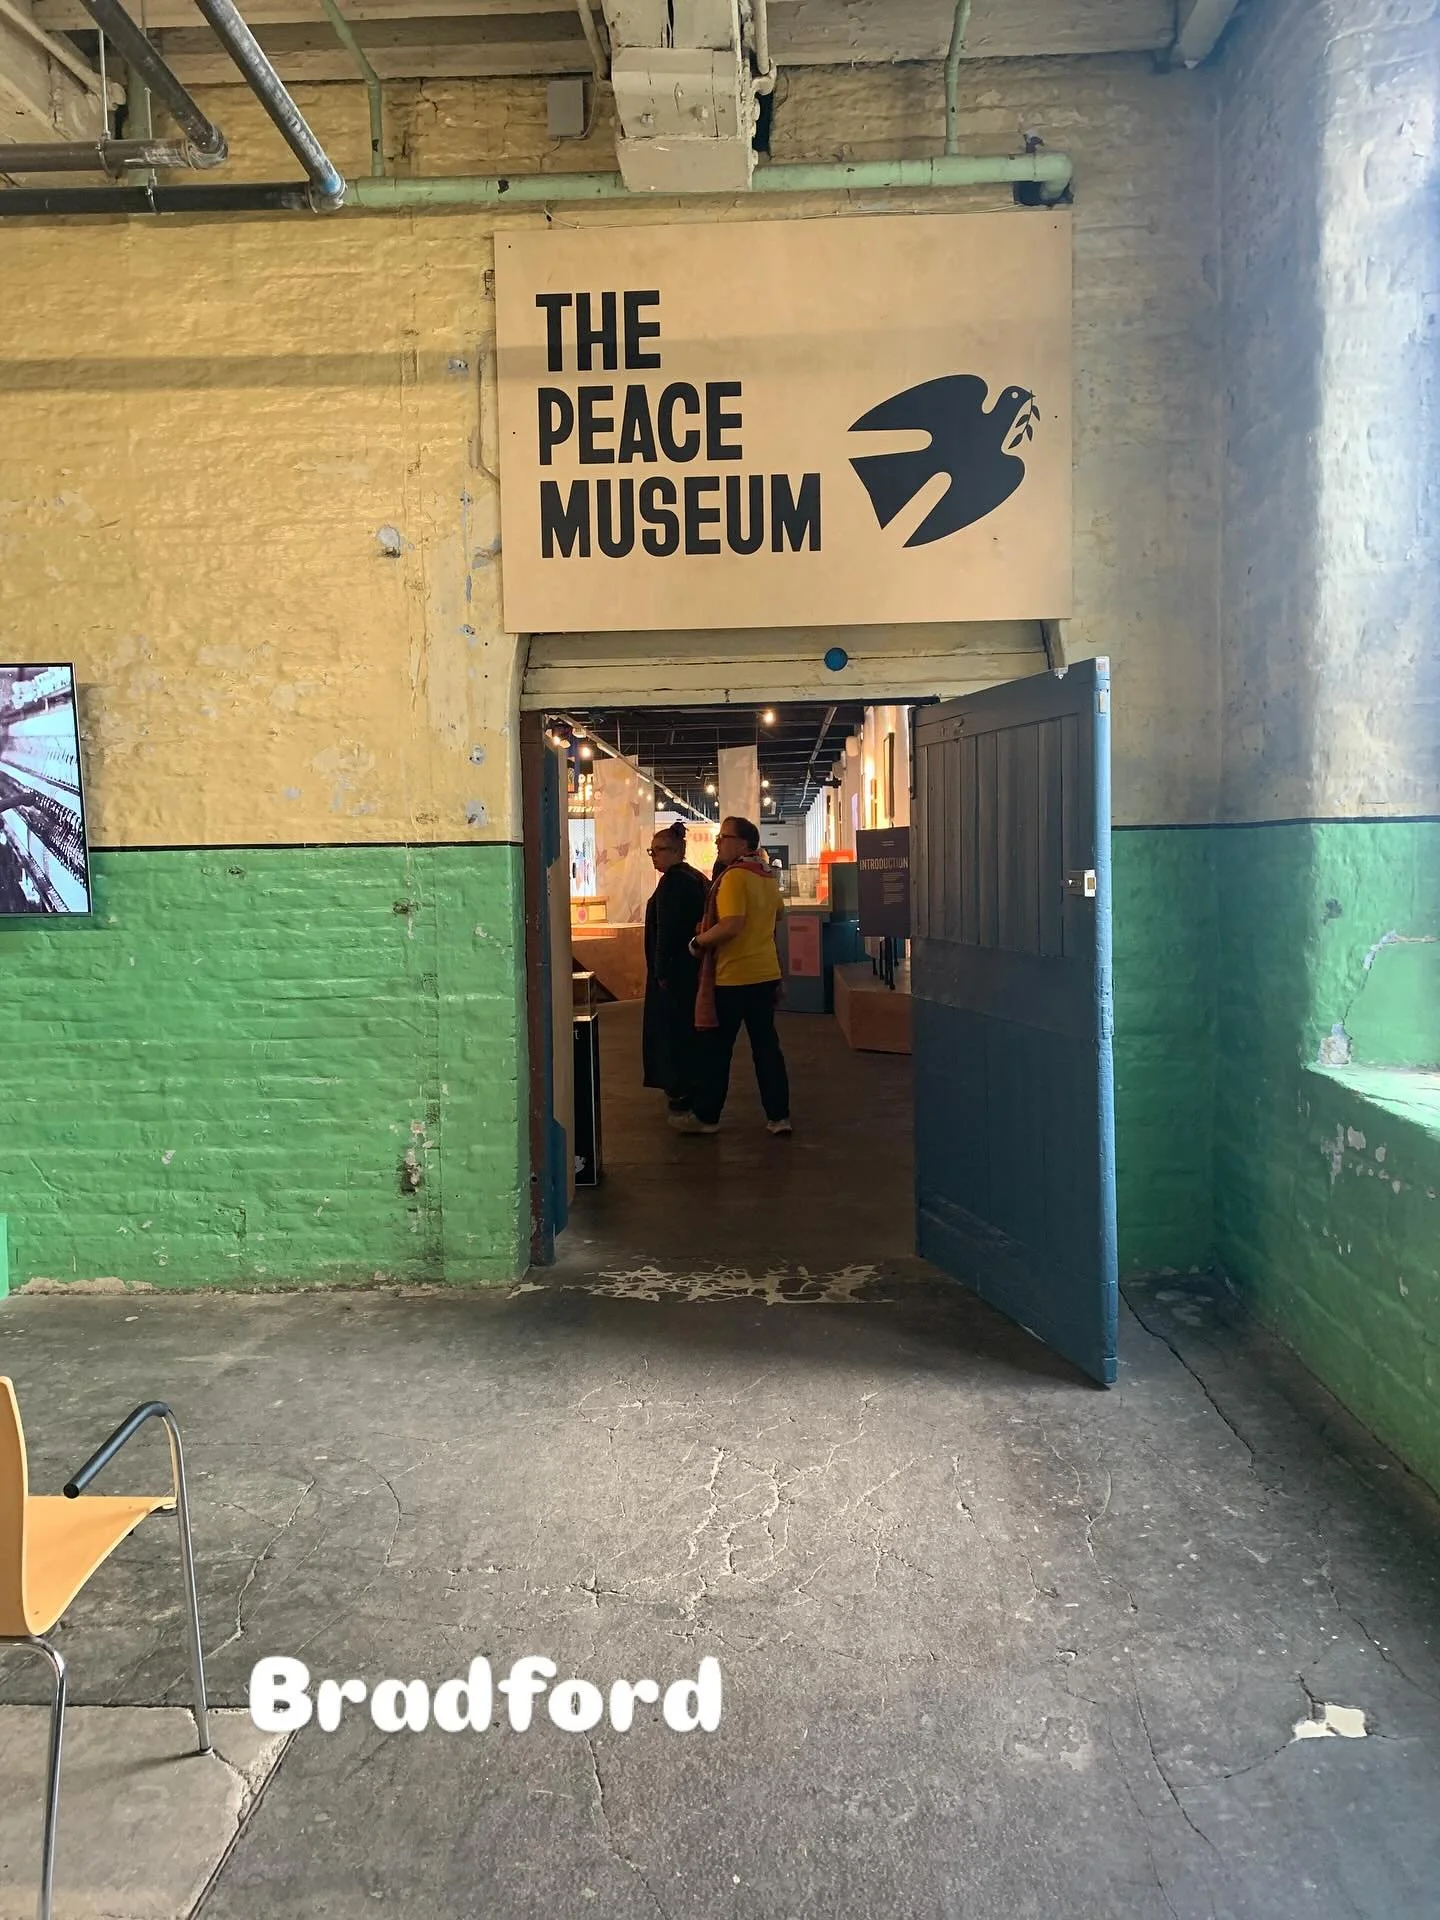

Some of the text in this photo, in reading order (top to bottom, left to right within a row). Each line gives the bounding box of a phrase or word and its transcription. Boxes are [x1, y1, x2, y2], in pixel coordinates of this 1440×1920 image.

[535, 289, 661, 372] THE
[537, 381, 743, 466] PEACE
[540, 472, 822, 560] MUSEUM
[860, 857, 909, 870] INTRODUCTION
